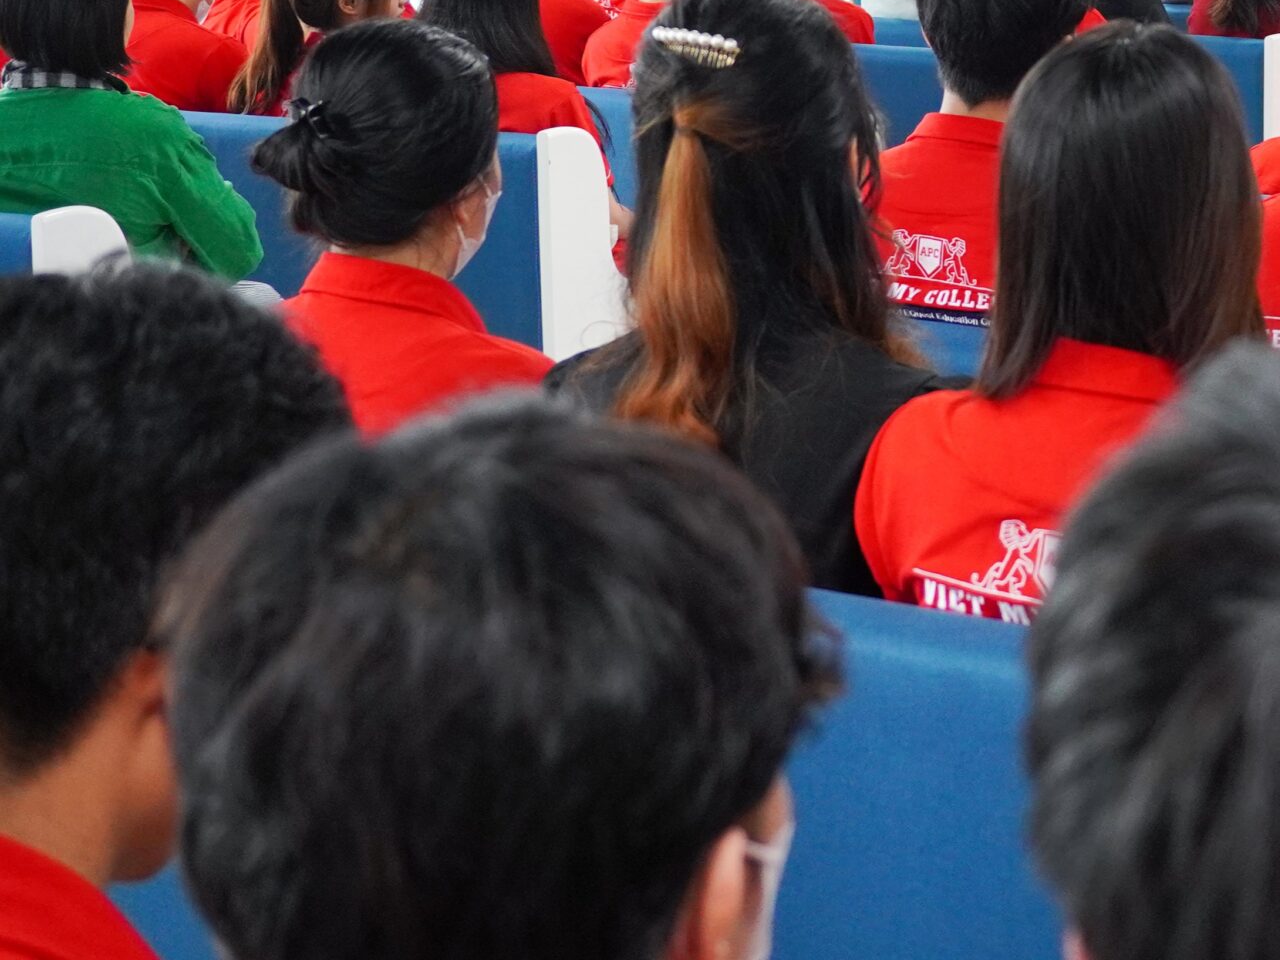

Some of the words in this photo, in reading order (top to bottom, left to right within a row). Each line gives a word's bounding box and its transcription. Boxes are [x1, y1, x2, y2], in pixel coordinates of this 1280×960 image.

[920, 246, 939, 258] APC
[887, 282, 921, 301] MY
[924, 289, 995, 310] COLLE
[924, 578, 985, 616] VIET
[997, 600, 1037, 626] M
